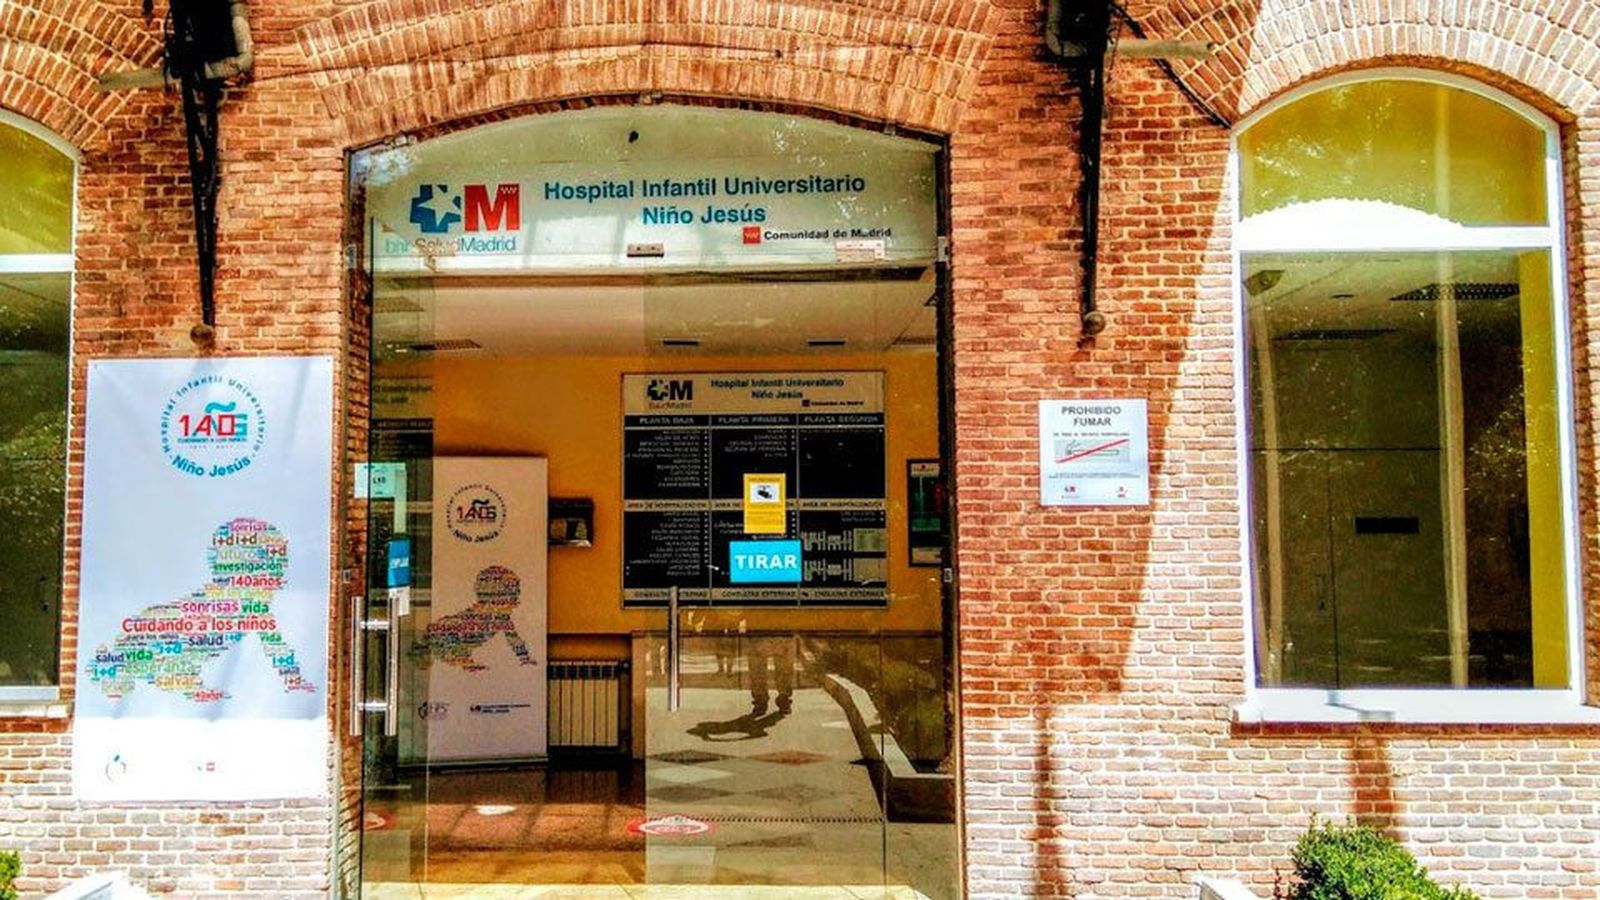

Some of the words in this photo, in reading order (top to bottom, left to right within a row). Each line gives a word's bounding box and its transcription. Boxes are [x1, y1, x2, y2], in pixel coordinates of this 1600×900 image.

[544, 180, 634, 203] Hospital
[642, 178, 717, 197] Infantil
[724, 174, 866, 195] Universitario
[642, 206, 693, 225] Niño
[701, 203, 766, 223] Jesús
[764, 230, 829, 240] Comunidad
[833, 229, 848, 238] de
[711, 379, 749, 390] Hospital
[751, 378, 783, 388] Infantil
[785, 377, 845, 388] Universitario
[751, 390, 773, 399] Niño
[1061, 406, 1122, 415] PROHIBIDO
[1073, 417, 1112, 427] FUMAR
[171, 455, 205, 476] Niño
[209, 456, 251, 478] Jesús
[735, 554, 798, 569] TIRAR
[230, 575, 282, 587] 140años
[182, 601, 239, 613] sonrisas
[241, 600, 270, 614] vida
[122, 617, 194, 633] Cuidando
[198, 620, 207, 632] a
[211, 617, 233, 631] los
[237, 614, 277, 631] niños
[187, 634, 224, 647] salud
[125, 648, 154, 661] vida
